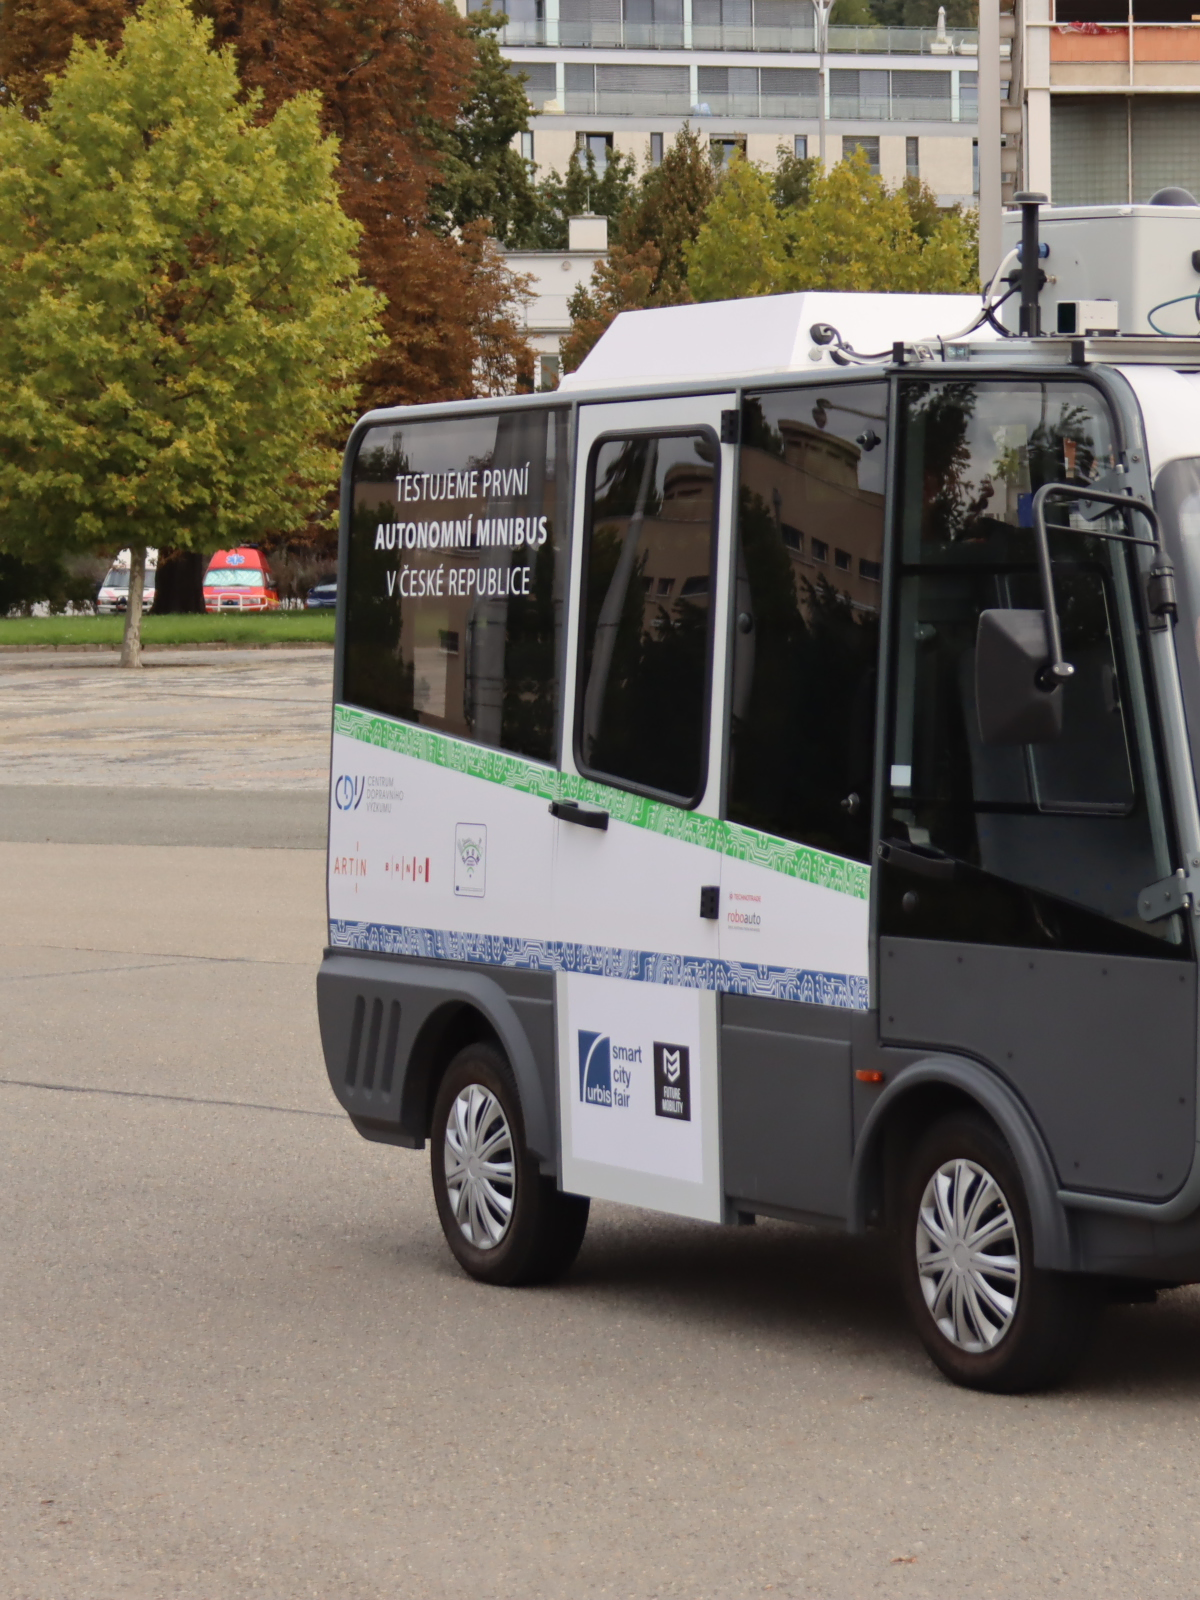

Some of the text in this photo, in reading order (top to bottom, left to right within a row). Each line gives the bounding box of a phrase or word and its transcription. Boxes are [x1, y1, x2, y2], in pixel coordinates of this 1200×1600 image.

[396, 461, 530, 502] TESTUJEME PRVNÍ
[374, 513, 548, 550] AUTONOMNÍ MINIBUS
[386, 563, 531, 597] V ČESKÉ REPUBLICE
[367, 775, 394, 787] CENTRUM
[333, 856, 367, 877] ARTIN
[727, 909, 761, 925] roboauto
[612, 1045, 642, 1064] smart
[613, 1065, 631, 1089] city
[587, 1083, 611, 1104] urbis
[613, 1088, 630, 1108] fair
[663, 1085, 681, 1100] FUTURE
[662, 1098, 683, 1114] MOBILITY
